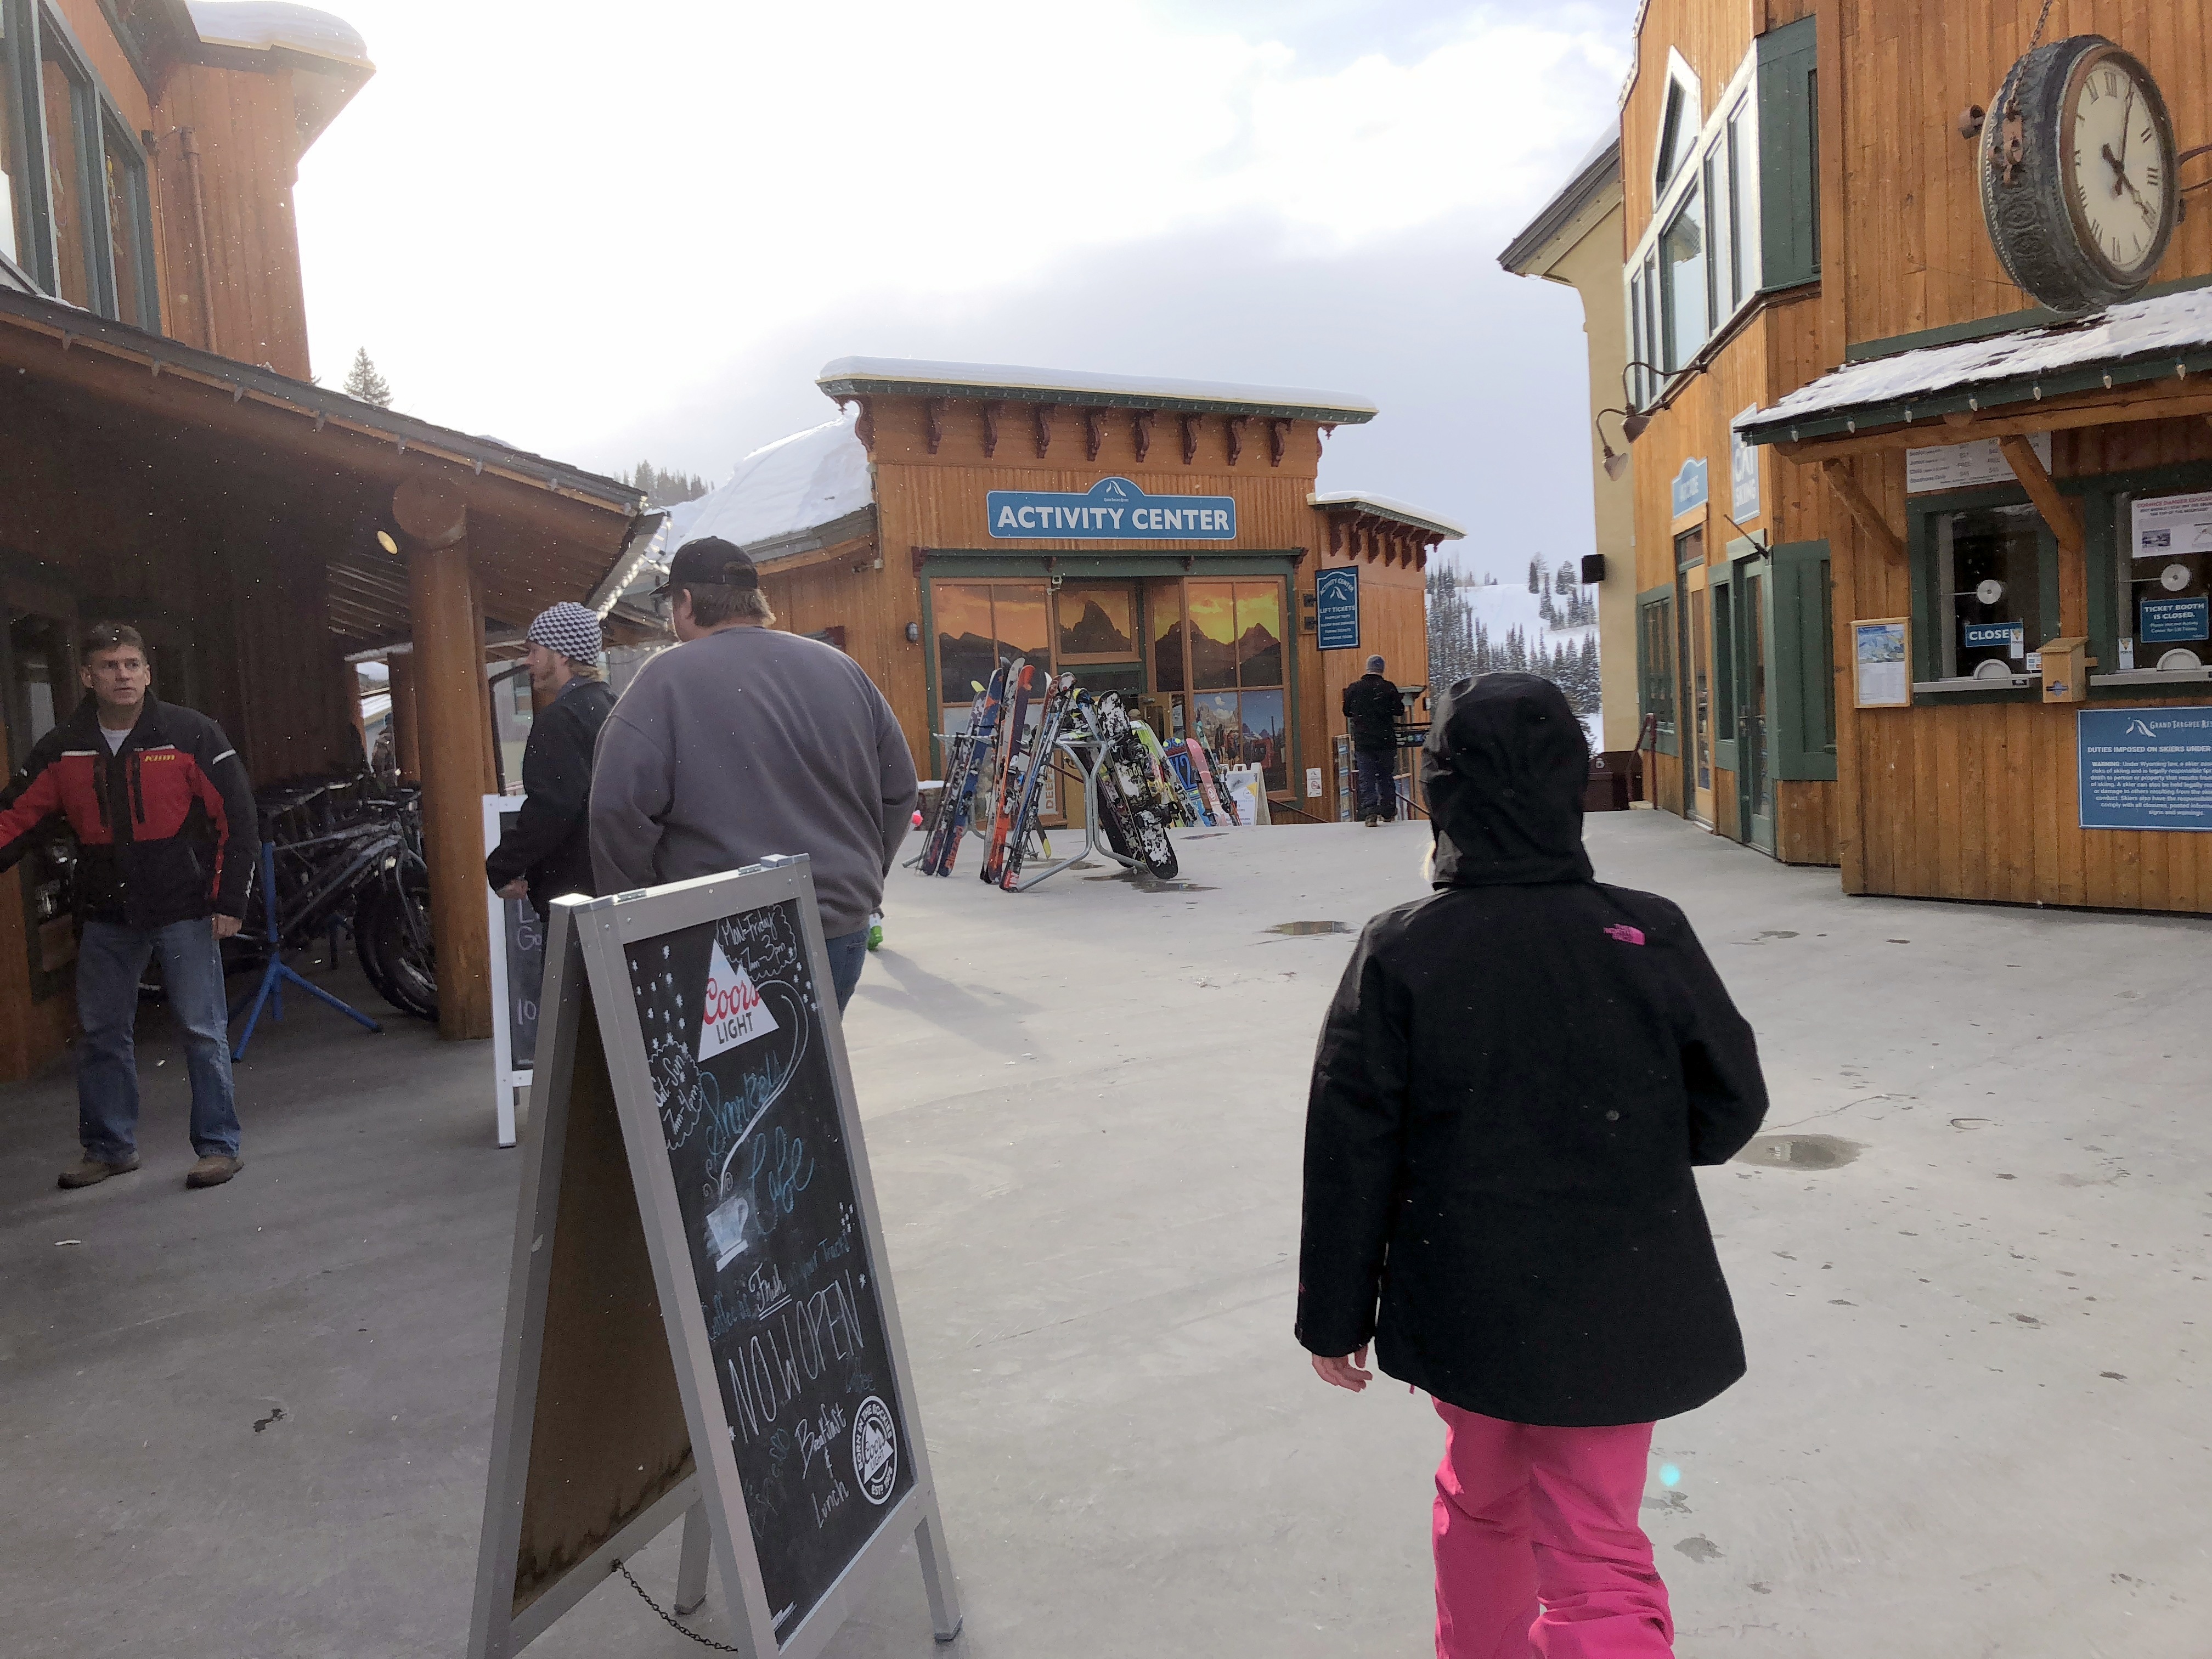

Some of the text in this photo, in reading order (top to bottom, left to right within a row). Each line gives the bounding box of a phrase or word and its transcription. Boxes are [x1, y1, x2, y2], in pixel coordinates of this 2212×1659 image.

[997, 505, 1229, 531] ACTIVITY CENTER
[1338, 578, 1354, 592] CENTER
[1969, 629, 2010, 641] CLOSE
[2149, 721, 2171, 730] GRAND
[2172, 720, 2200, 729] TARGHEE
[703, 978, 761, 1025] Coors
[715, 1011, 753, 1045] LIGHT
[729, 1268, 864, 1443] NOW OPEN
[857, 1418, 865, 1433] IN
[861, 1404, 872, 1420] THE
[872, 1403, 892, 1439] ROCKIES
[865, 1435, 885, 1464] Coors
[870, 1448, 884, 1471] LIGHT
[812, 1479, 849, 1528] Lunch
